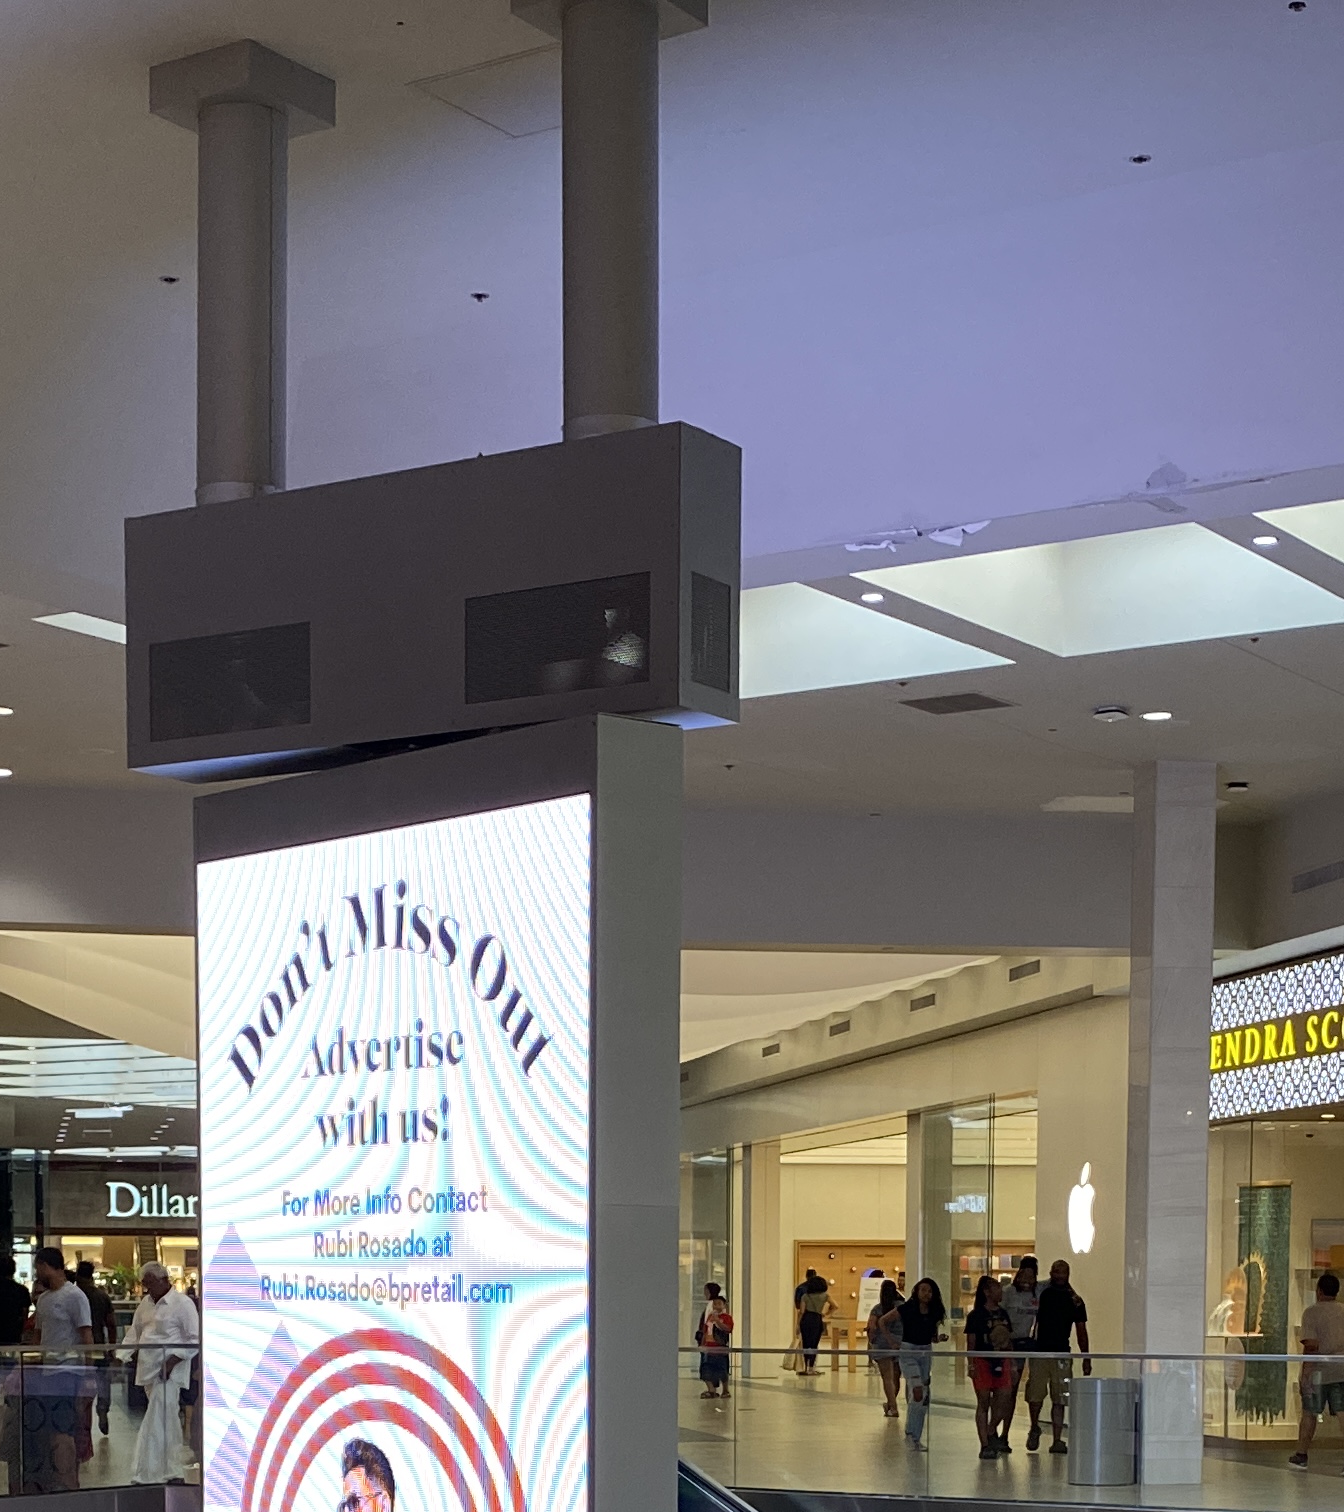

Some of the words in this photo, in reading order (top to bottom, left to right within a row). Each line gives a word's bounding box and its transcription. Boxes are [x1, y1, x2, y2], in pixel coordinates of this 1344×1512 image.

[227, 919, 336, 1094] Don't
[342, 879, 460, 968] Miss
[470, 933, 555, 1079] Out
[301, 1018, 465, 1079] Advertise
[1210, 1019, 1296, 1070] ENDRA
[316, 1095, 390, 1147] with
[397, 1094, 451, 1144] us!
[282, 1190, 309, 1217] For
[313, 1188, 360, 1216] More
[365, 1186, 402, 1215] Info
[407, 1185, 488, 1214] Contact
[313, 1230, 354, 1259] Rubi
[358, 1229, 426, 1258] Rosado
[433, 1231, 452, 1258] at
[260, 1272, 514, 1310] Rubi.Rosado@bpretail.com
